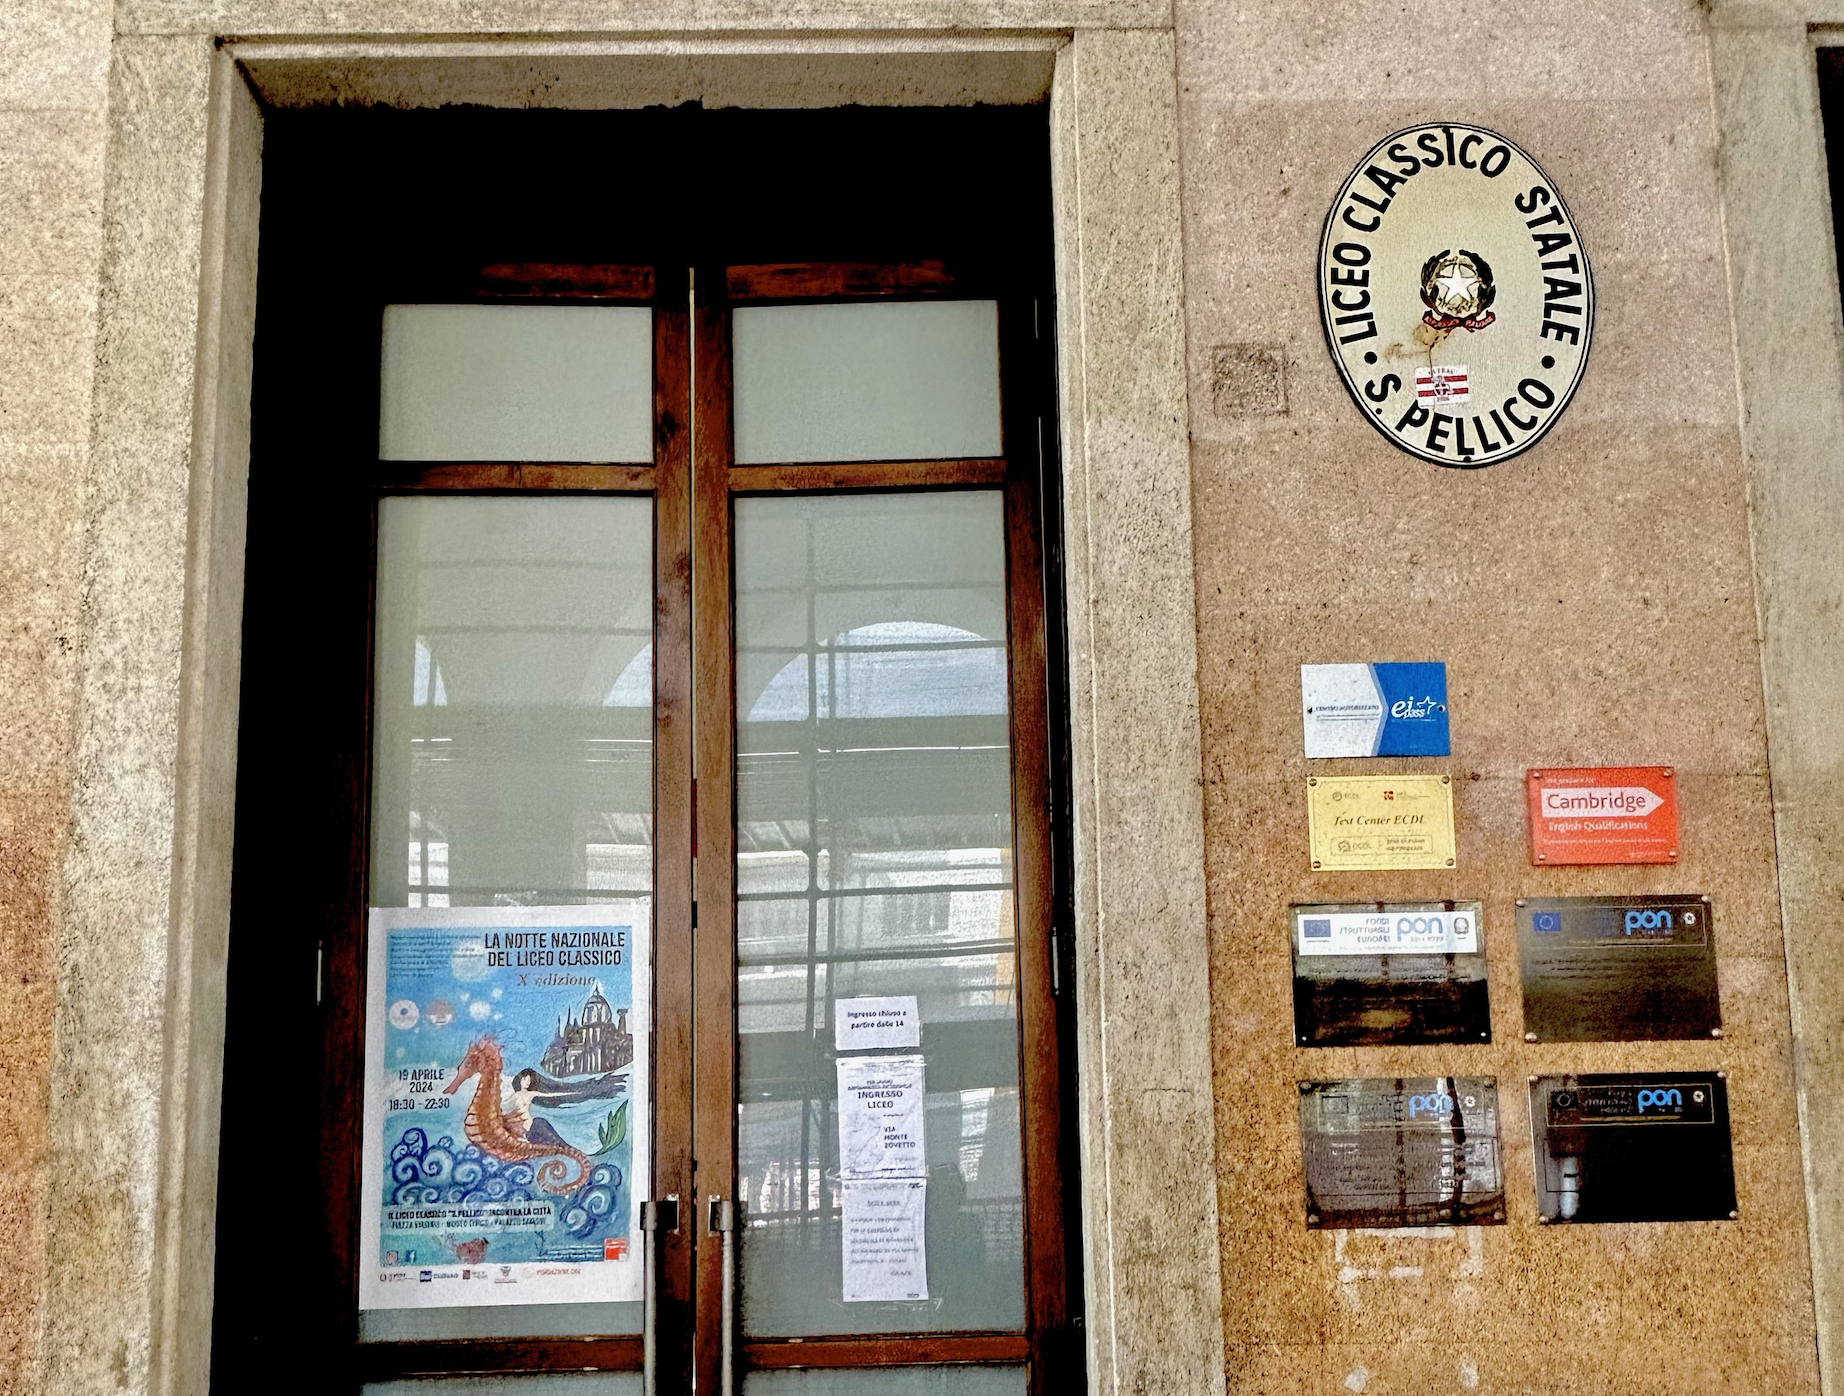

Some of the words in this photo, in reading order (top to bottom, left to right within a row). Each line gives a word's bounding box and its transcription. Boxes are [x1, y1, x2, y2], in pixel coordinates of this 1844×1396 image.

[1342, 130, 1511, 232] CLASSICO
[1515, 186, 1582, 346] STATALE
[1331, 242, 1378, 345] LICEO
[1364, 373, 1402, 415] S.
[1395, 378, 1555, 456] PELLICO
[1547, 792, 1646, 813] Cambridge
[1334, 816, 1354, 826] Test
[1356, 815, 1391, 826] Center
[1393, 815, 1425, 825] ECDL
[1548, 822, 1582, 834] English
[1583, 821, 1648, 833] Qualifications
[1396, 917, 1443, 942] pon
[1624, 909, 1672, 936] pon
[485, 933, 500, 949] LA
[505, 932, 547, 949] NOTTE
[551, 932, 625, 948] NAZIONALE
[488, 951, 512, 966] DEL
[517, 951, 554, 966] LICEO
[558, 950, 621, 966] CLASSICO
[534, 973, 596, 987] edizione
[399, 1069, 409, 1081] 19
[411, 1068, 445, 1081] APRILE
[409, 1081, 433, 1093] 2024
[857, 1090, 903, 1099] INGRESSO
[1637, 1088, 1683, 1114] pon
[389, 1098, 415, 1111] 18:30
[424, 1098, 450, 1110] 22:30
[867, 1100, 894, 1109] LICEO
[883, 1133, 908, 1141] MONTE
[884, 1141, 916, 1149] ZOVETTO
[395, 1211, 415, 1220] LICEO
[415, 1210, 447, 1219] CLASSICO
